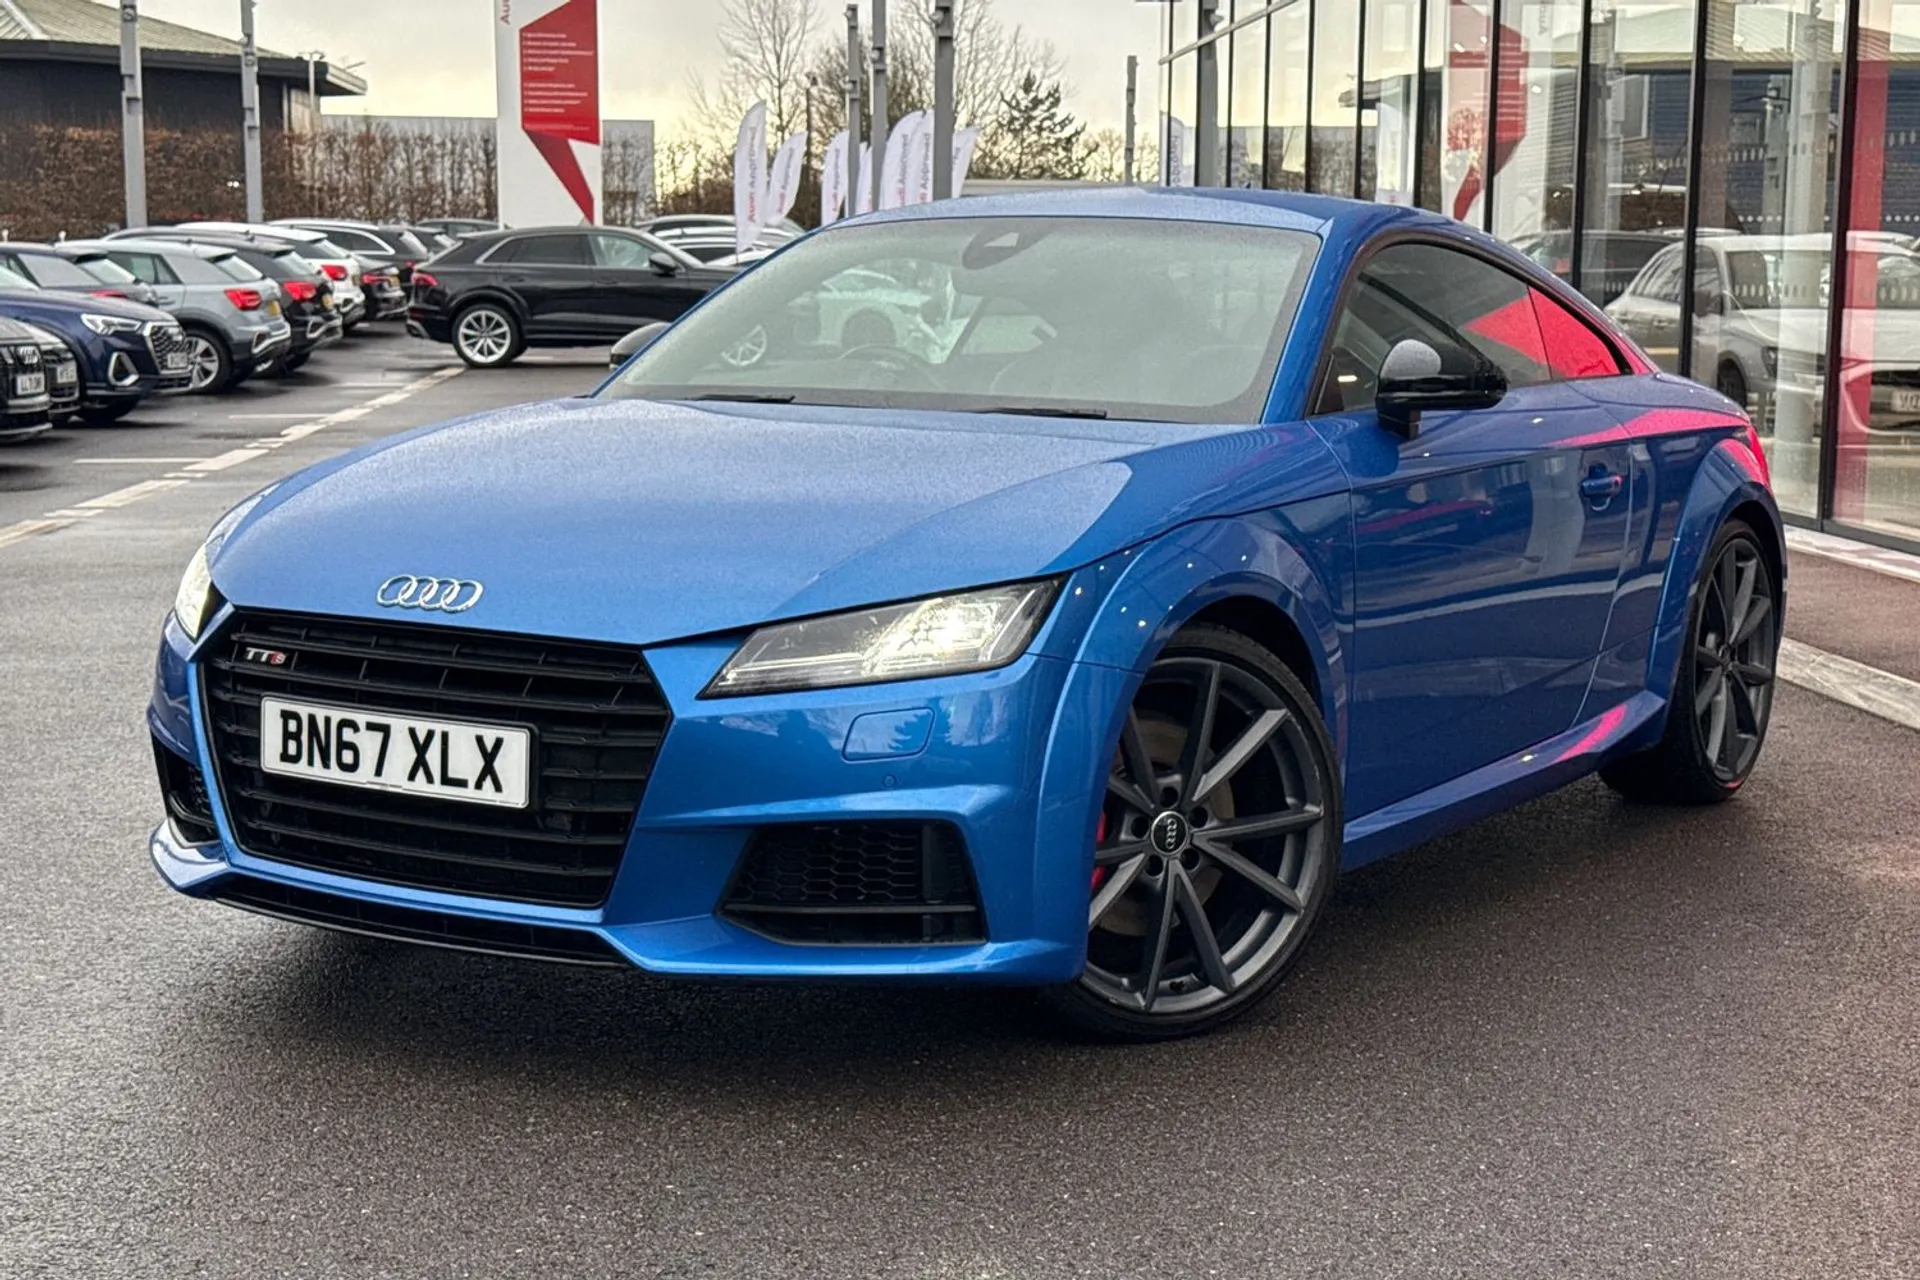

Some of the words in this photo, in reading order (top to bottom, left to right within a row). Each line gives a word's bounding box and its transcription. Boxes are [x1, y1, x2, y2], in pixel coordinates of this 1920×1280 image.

[920, 132, 931, 190] Approved
[279, 709, 391, 778] BN67
[407, 726, 504, 794] XLX
